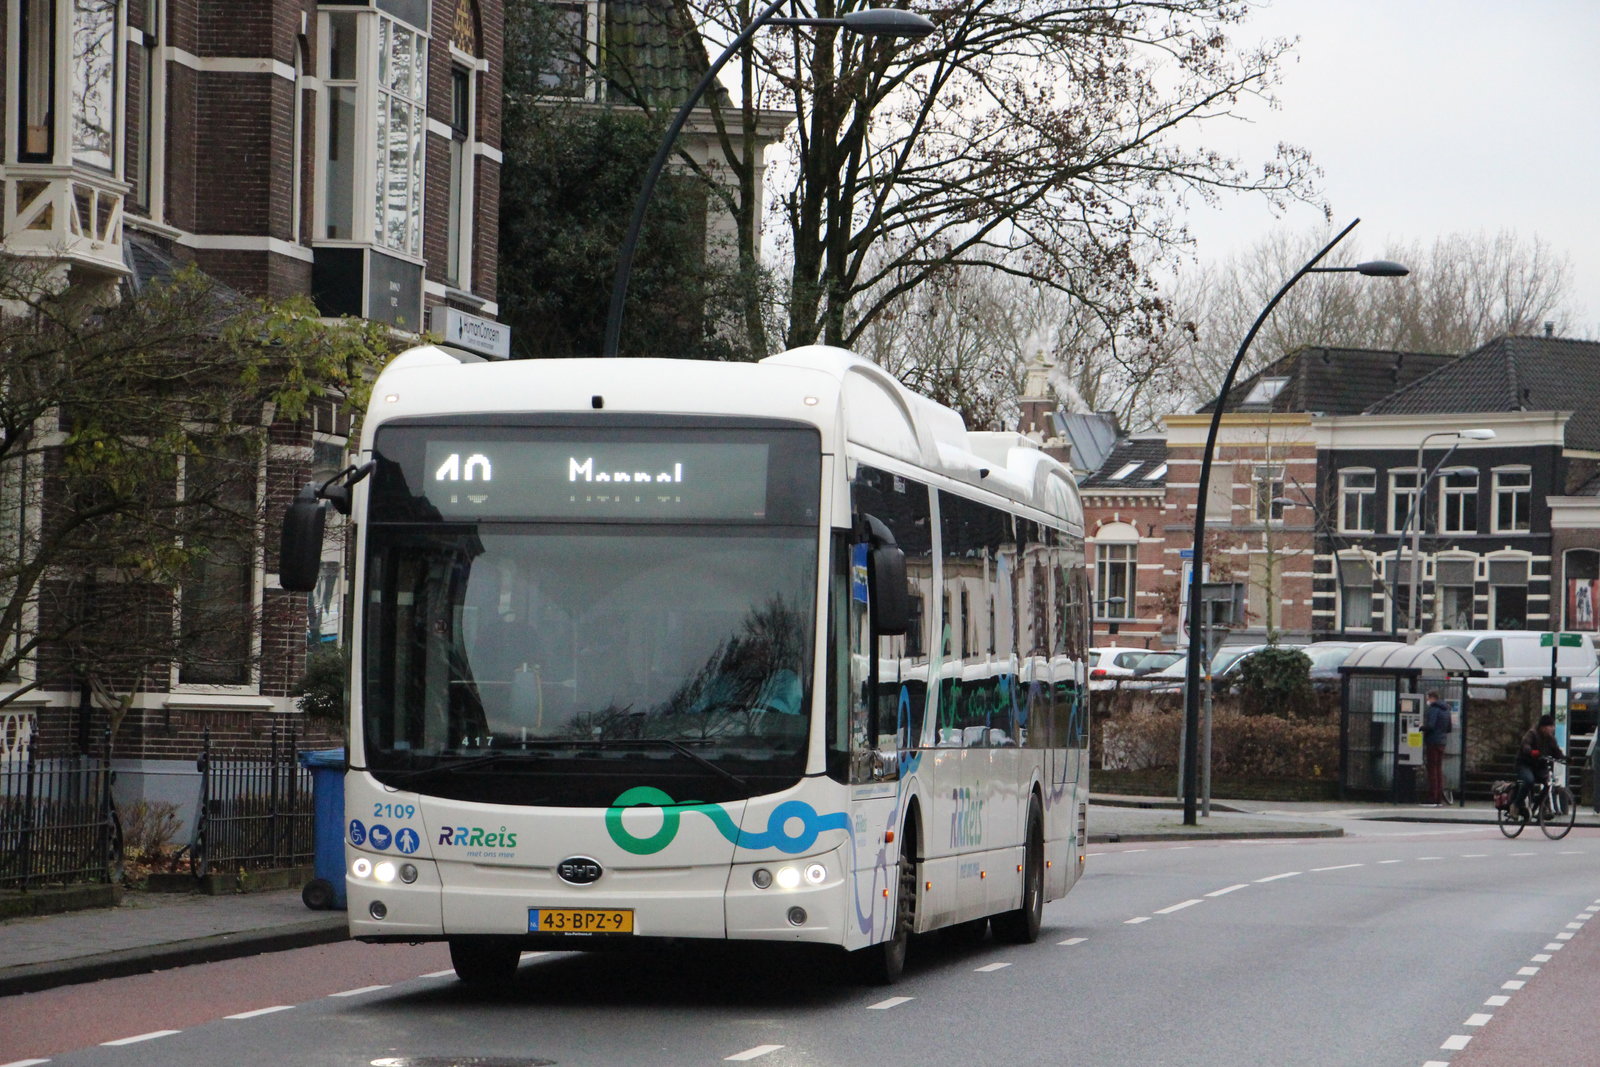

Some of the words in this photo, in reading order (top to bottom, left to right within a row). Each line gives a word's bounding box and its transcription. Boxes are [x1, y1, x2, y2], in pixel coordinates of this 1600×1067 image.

[373, 803, 415, 819] 2109
[438, 826, 517, 848] RRReis
[562, 864, 597, 878] BYD
[543, 913, 623, 929] 43-BPZ-9
